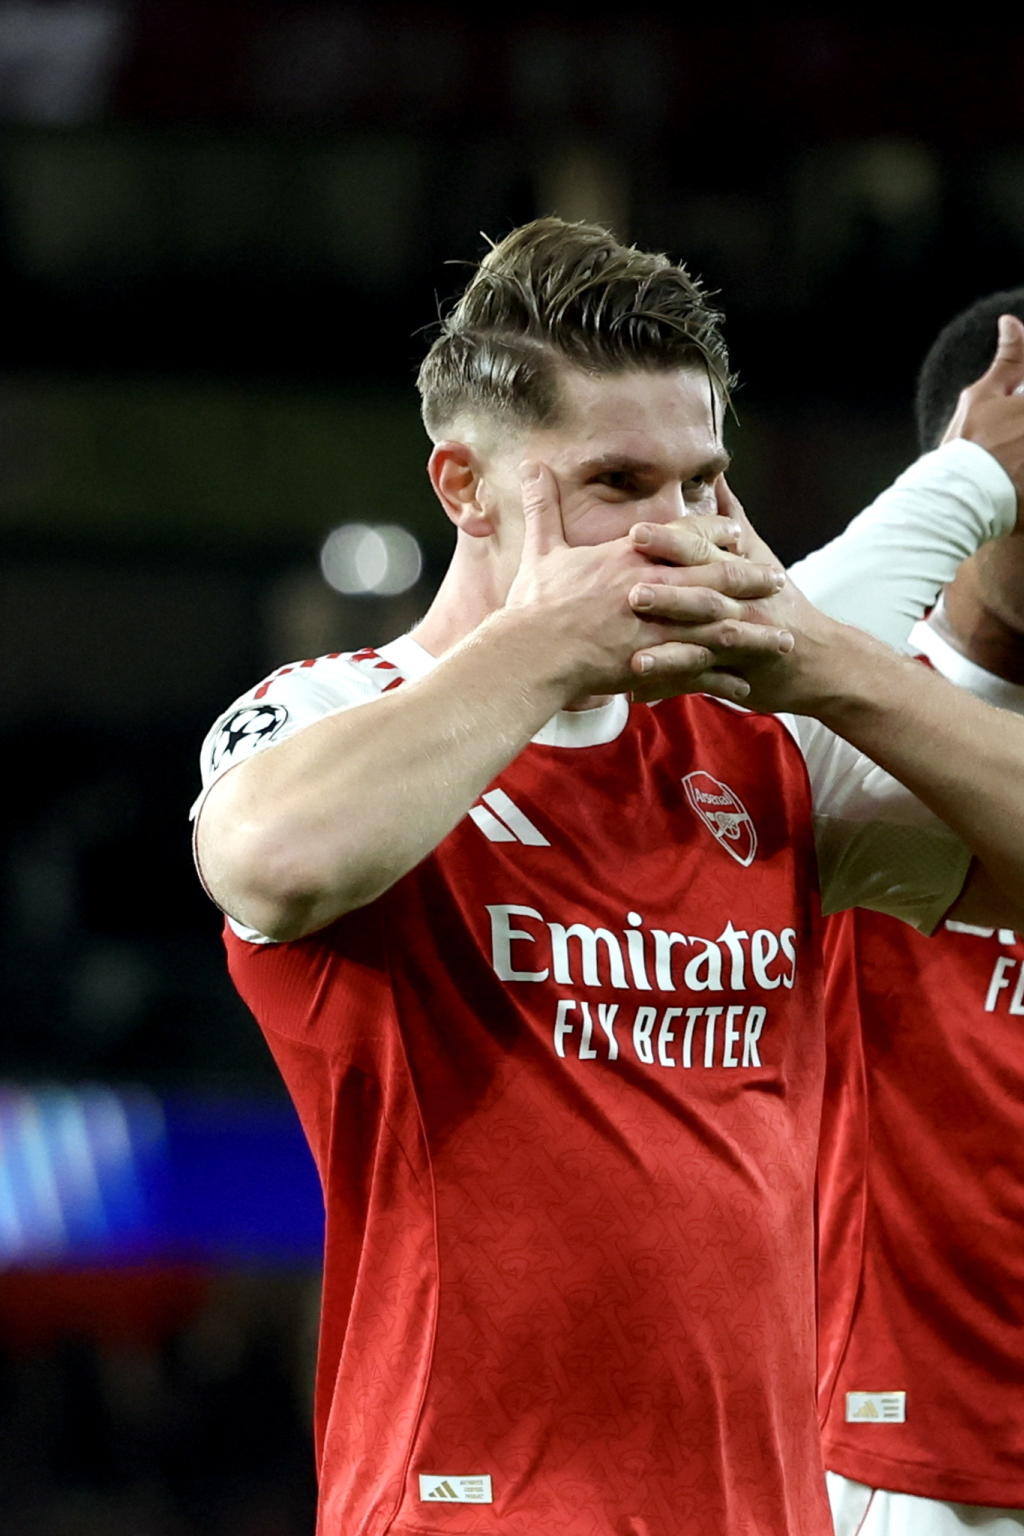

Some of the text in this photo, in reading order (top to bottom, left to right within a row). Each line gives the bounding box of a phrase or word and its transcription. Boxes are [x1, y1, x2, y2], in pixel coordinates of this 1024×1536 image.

[484, 904, 797, 991] Emirates
[553, 999, 767, 1068] FLY BETTER
